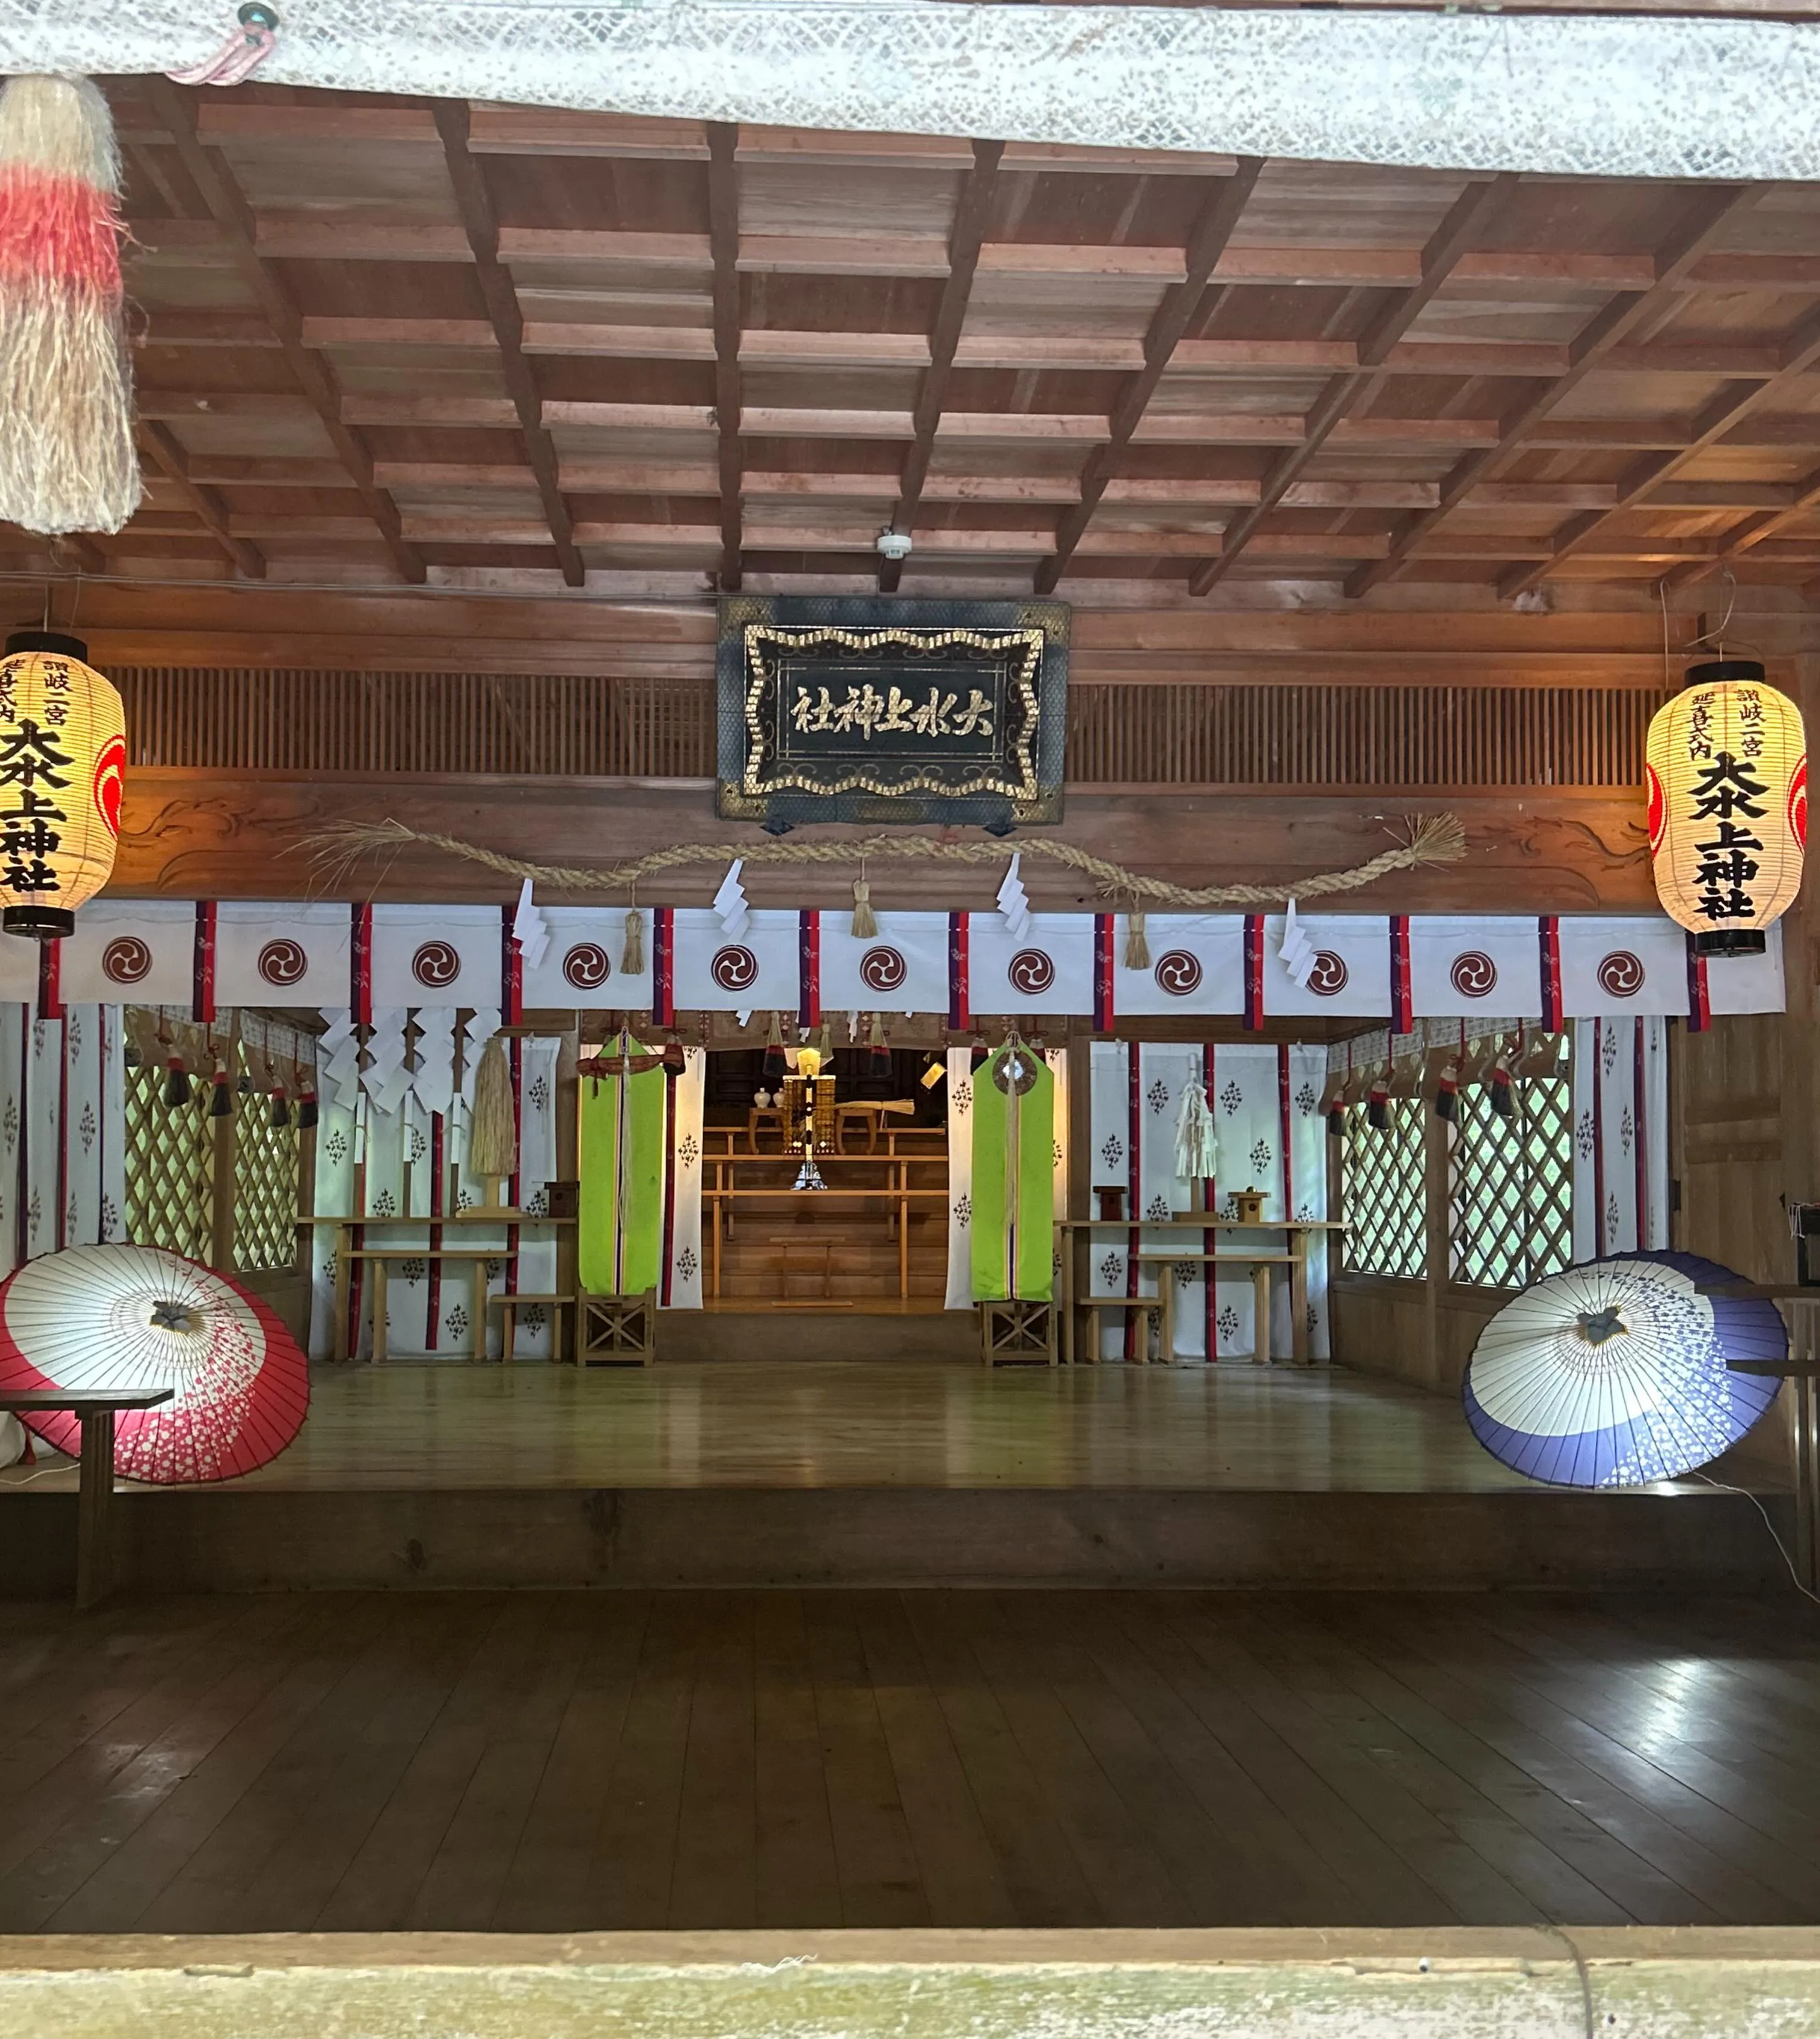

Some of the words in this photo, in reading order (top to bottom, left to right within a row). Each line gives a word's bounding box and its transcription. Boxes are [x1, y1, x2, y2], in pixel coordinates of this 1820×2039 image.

[790, 683, 994, 740] 大水上神社
[1686, 691, 1716, 761] 延喜式内
[0, 717, 75, 892] 大水上神社
[1687, 750, 1771, 921] 大水上神社
